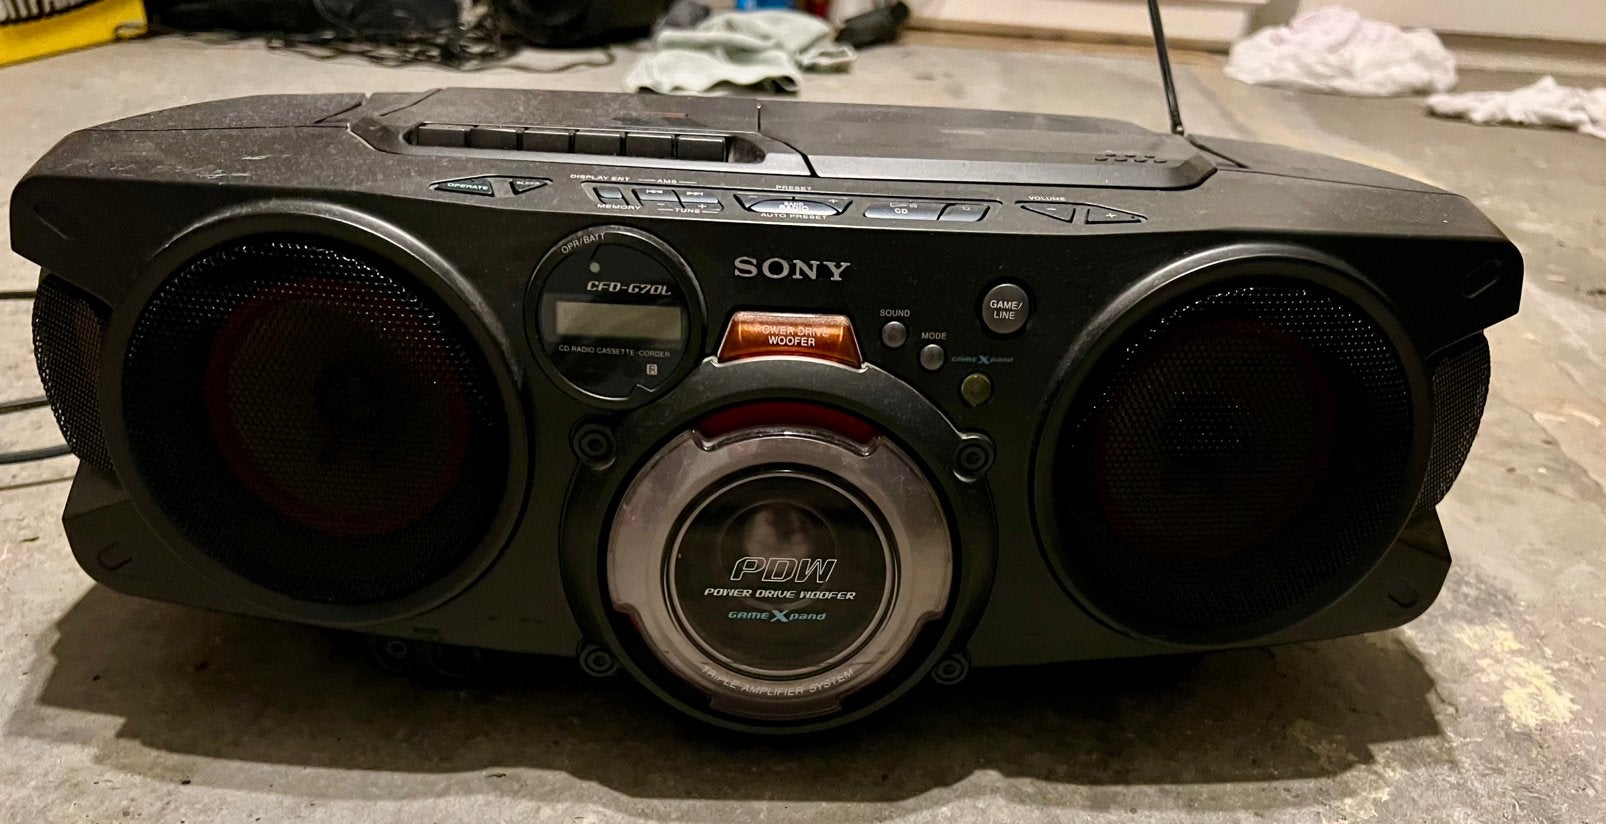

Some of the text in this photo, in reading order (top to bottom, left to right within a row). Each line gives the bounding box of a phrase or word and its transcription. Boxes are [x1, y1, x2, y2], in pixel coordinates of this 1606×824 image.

[447, 182, 489, 190] OPERATE
[597, 203, 641, 211] MEMORY
[561, 232, 606, 254] OPR/BATT
[734, 256, 851, 281] SONY
[586, 280, 672, 296] CFD-G70L
[989, 300, 1023, 310] GAME/
[880, 309, 911, 318] SOUND
[993, 310, 1016, 320] LINE
[755, 324, 831, 338] POWER DRIVE
[921, 331, 948, 340] MODE
[768, 335, 816, 347] WOOFER
[558, 344, 570, 352] CD
[596, 347, 671, 358] CASSETTE-CORDER
[729, 556, 838, 584] PDW
[704, 587, 857, 601] POWER DRIVE WOOFER
[701, 664, 855, 696] TRIPLE AMPLIFIER SYSTEM
